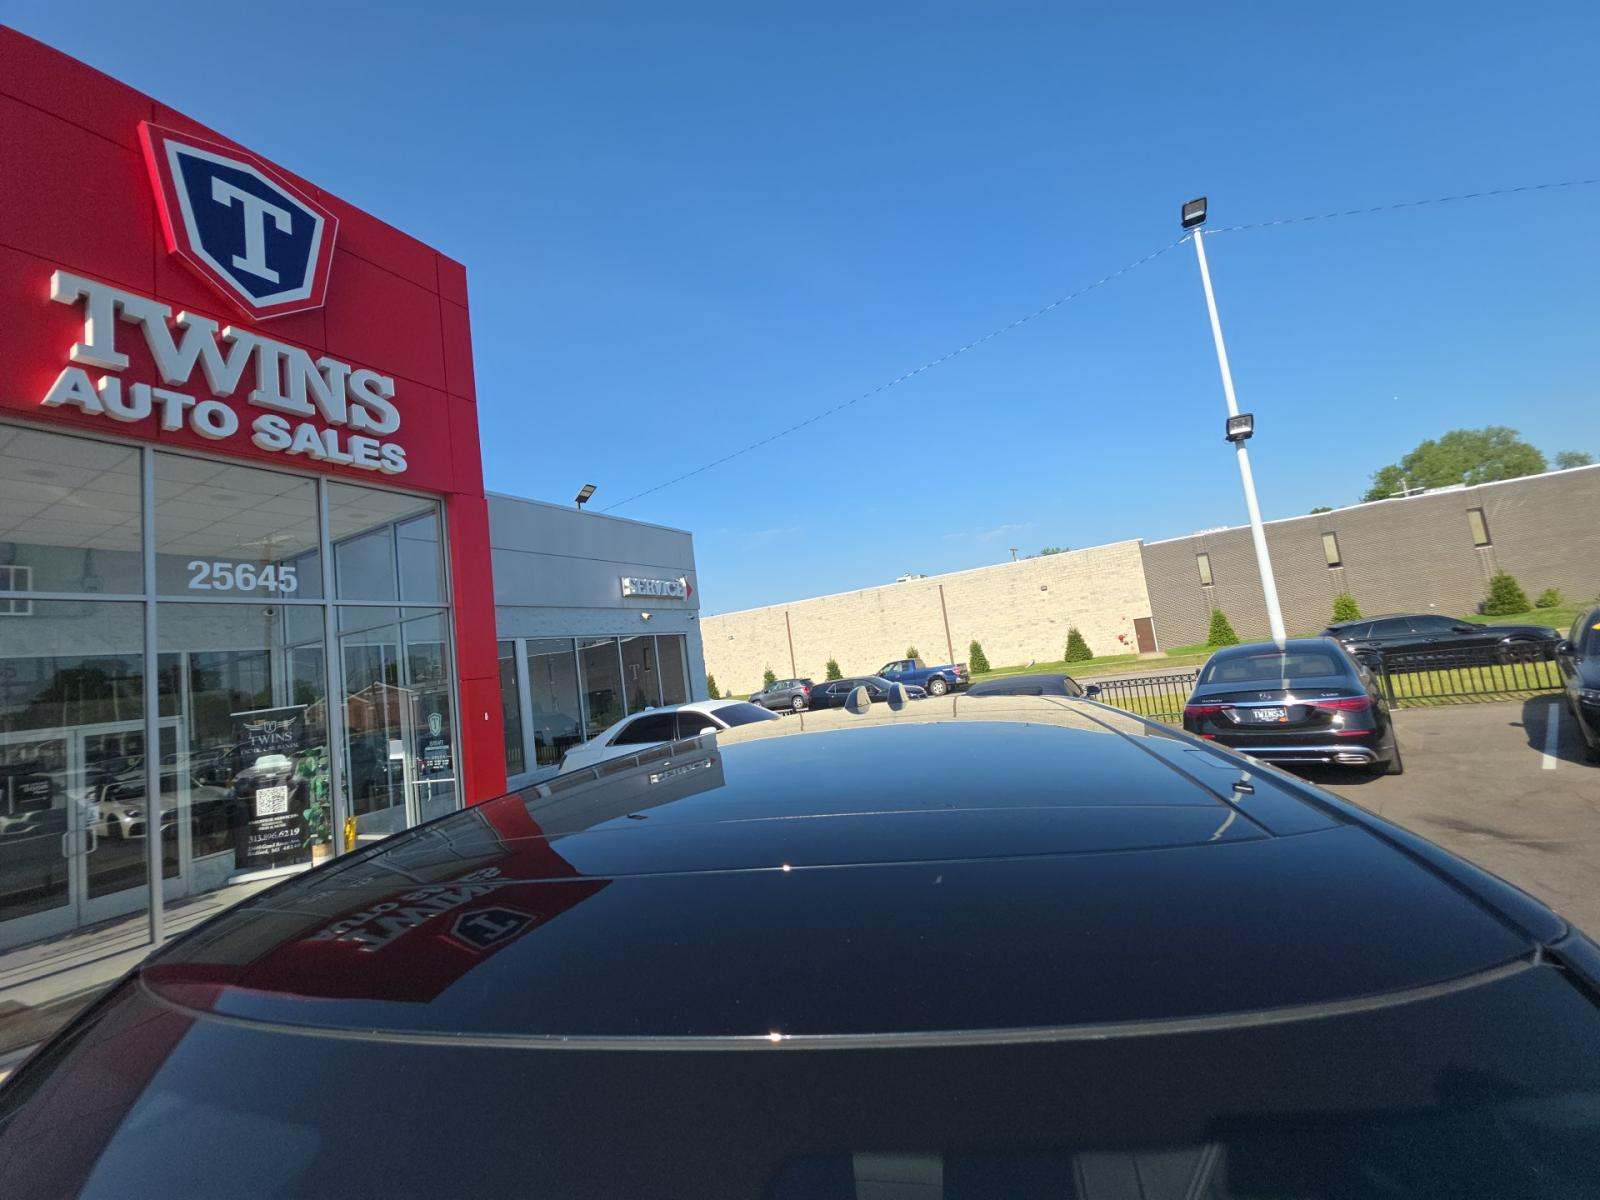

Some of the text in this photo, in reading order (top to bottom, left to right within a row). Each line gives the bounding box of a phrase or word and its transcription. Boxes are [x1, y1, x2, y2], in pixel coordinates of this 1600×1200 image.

[211, 175, 292, 284] T
[50, 270, 401, 436] TWINS
[41, 366, 408, 475] AUTO SALES
[187, 560, 298, 592] 25645
[248, 731, 293, 746] TWINS
